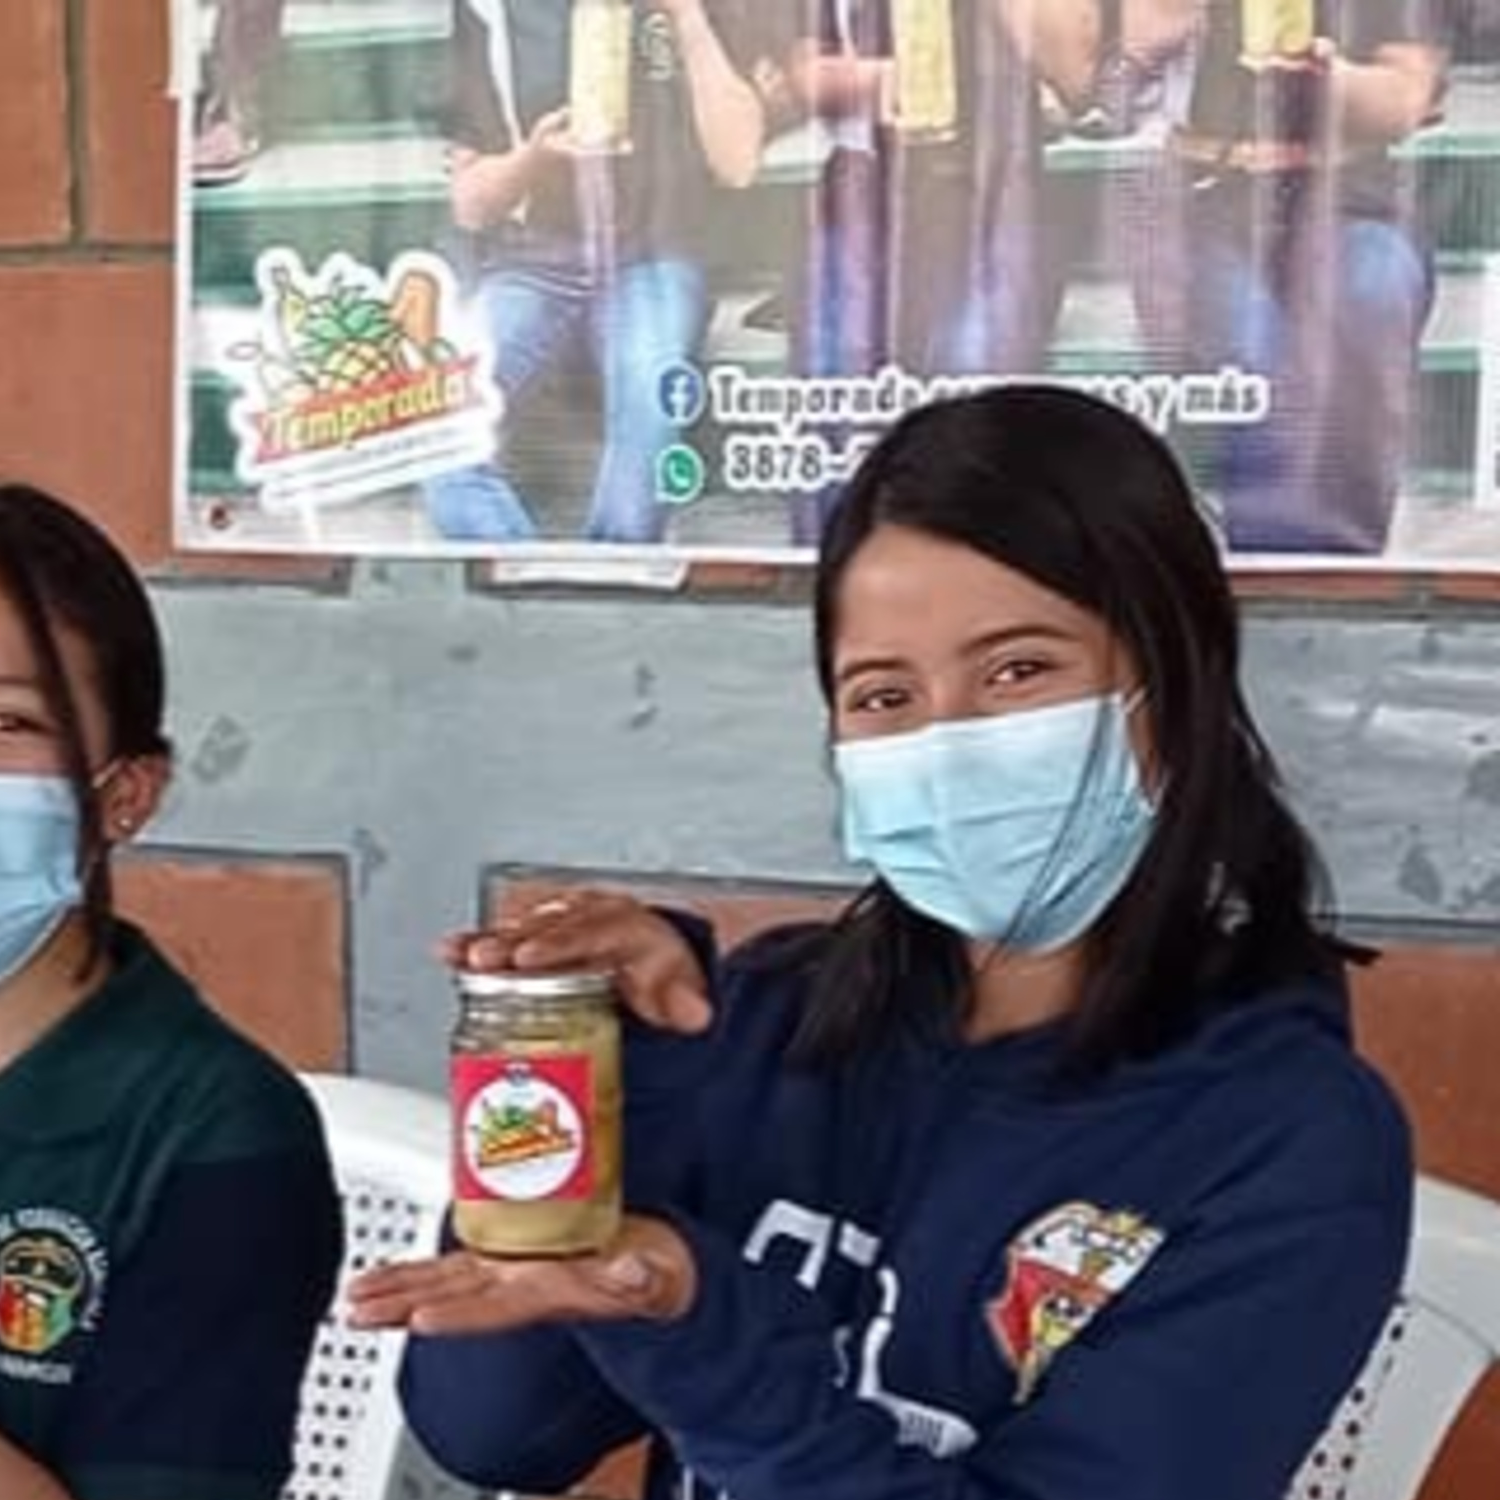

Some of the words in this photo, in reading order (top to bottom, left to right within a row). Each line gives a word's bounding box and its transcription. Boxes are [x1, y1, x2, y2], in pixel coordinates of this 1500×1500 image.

[266, 368, 467, 449] Temporada
[713, 369, 922, 427] Temporada
[1182, 370, 1264, 417] más
